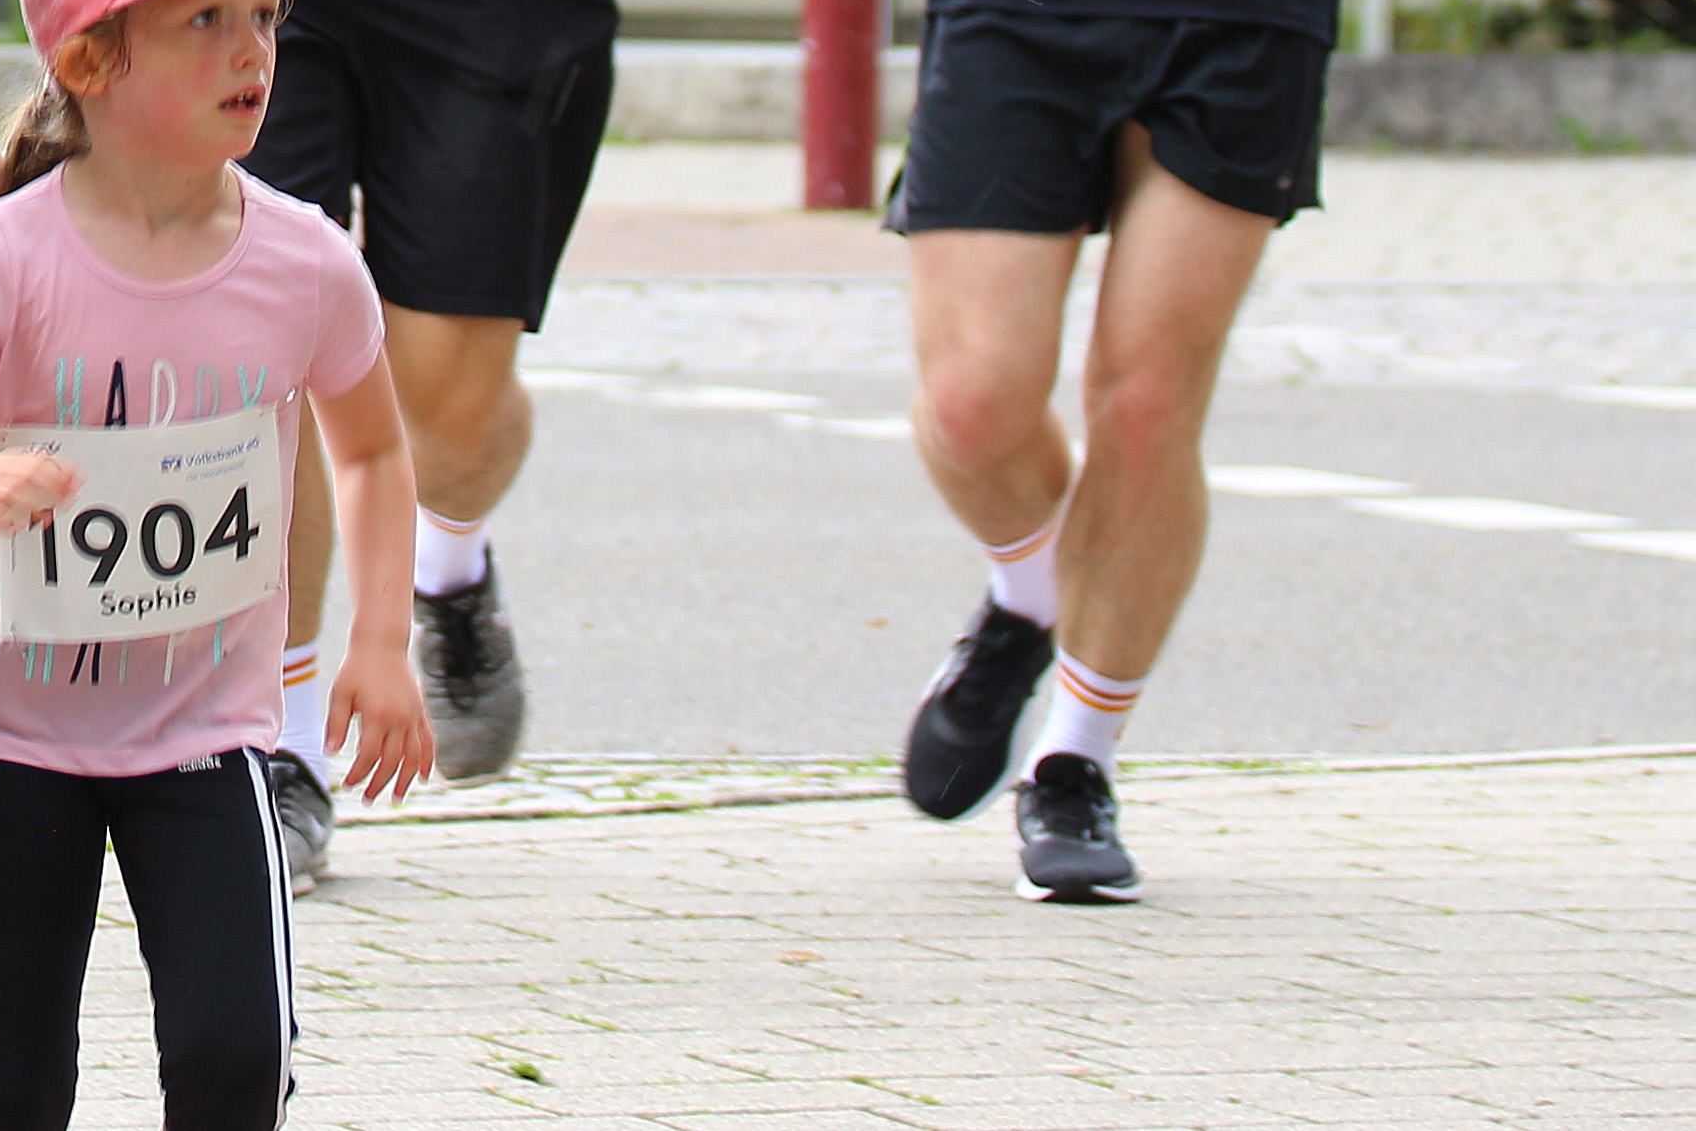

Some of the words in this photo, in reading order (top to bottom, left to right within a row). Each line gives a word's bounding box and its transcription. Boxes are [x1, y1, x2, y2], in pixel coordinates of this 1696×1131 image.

[184, 443, 245, 468] Volksbank
[29, 484, 260, 588] 1904
[99, 583, 198, 620] Sophie
